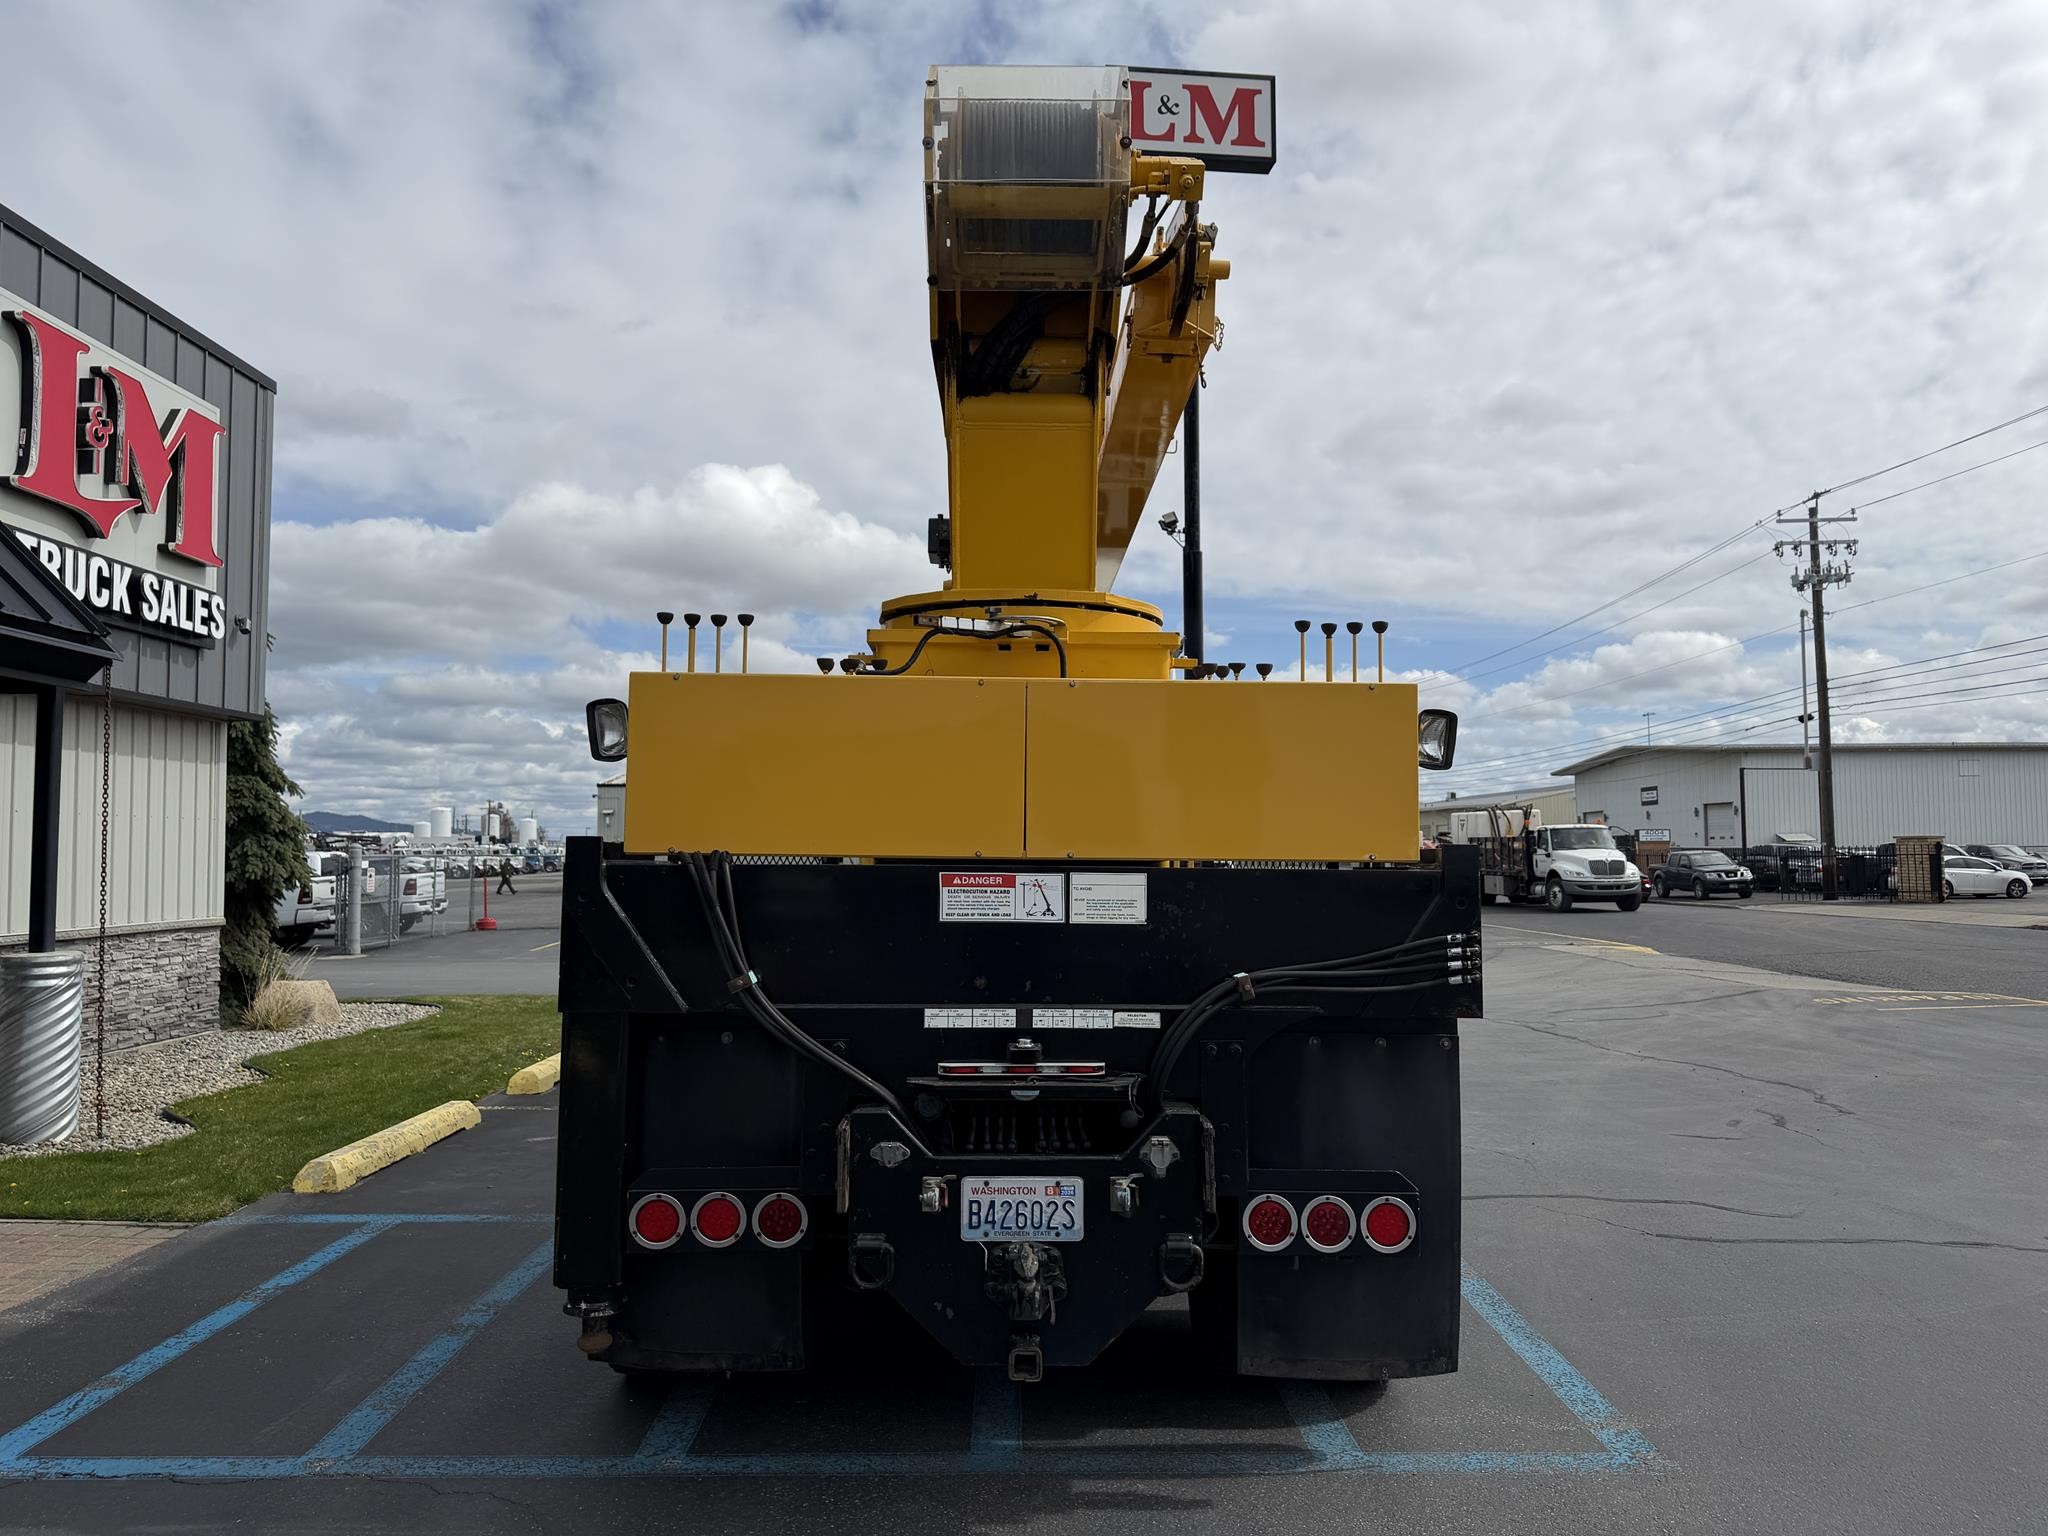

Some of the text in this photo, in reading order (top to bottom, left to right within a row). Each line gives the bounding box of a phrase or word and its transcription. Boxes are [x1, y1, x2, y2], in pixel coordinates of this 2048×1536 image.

[141, 572, 226, 640] SALES
[962, 876, 1003, 885] DANGER
[971, 1186, 1037, 1196] WASHINGTON
[1047, 1186, 1054, 1195] 8
[968, 1199, 1076, 1230] B42602S
